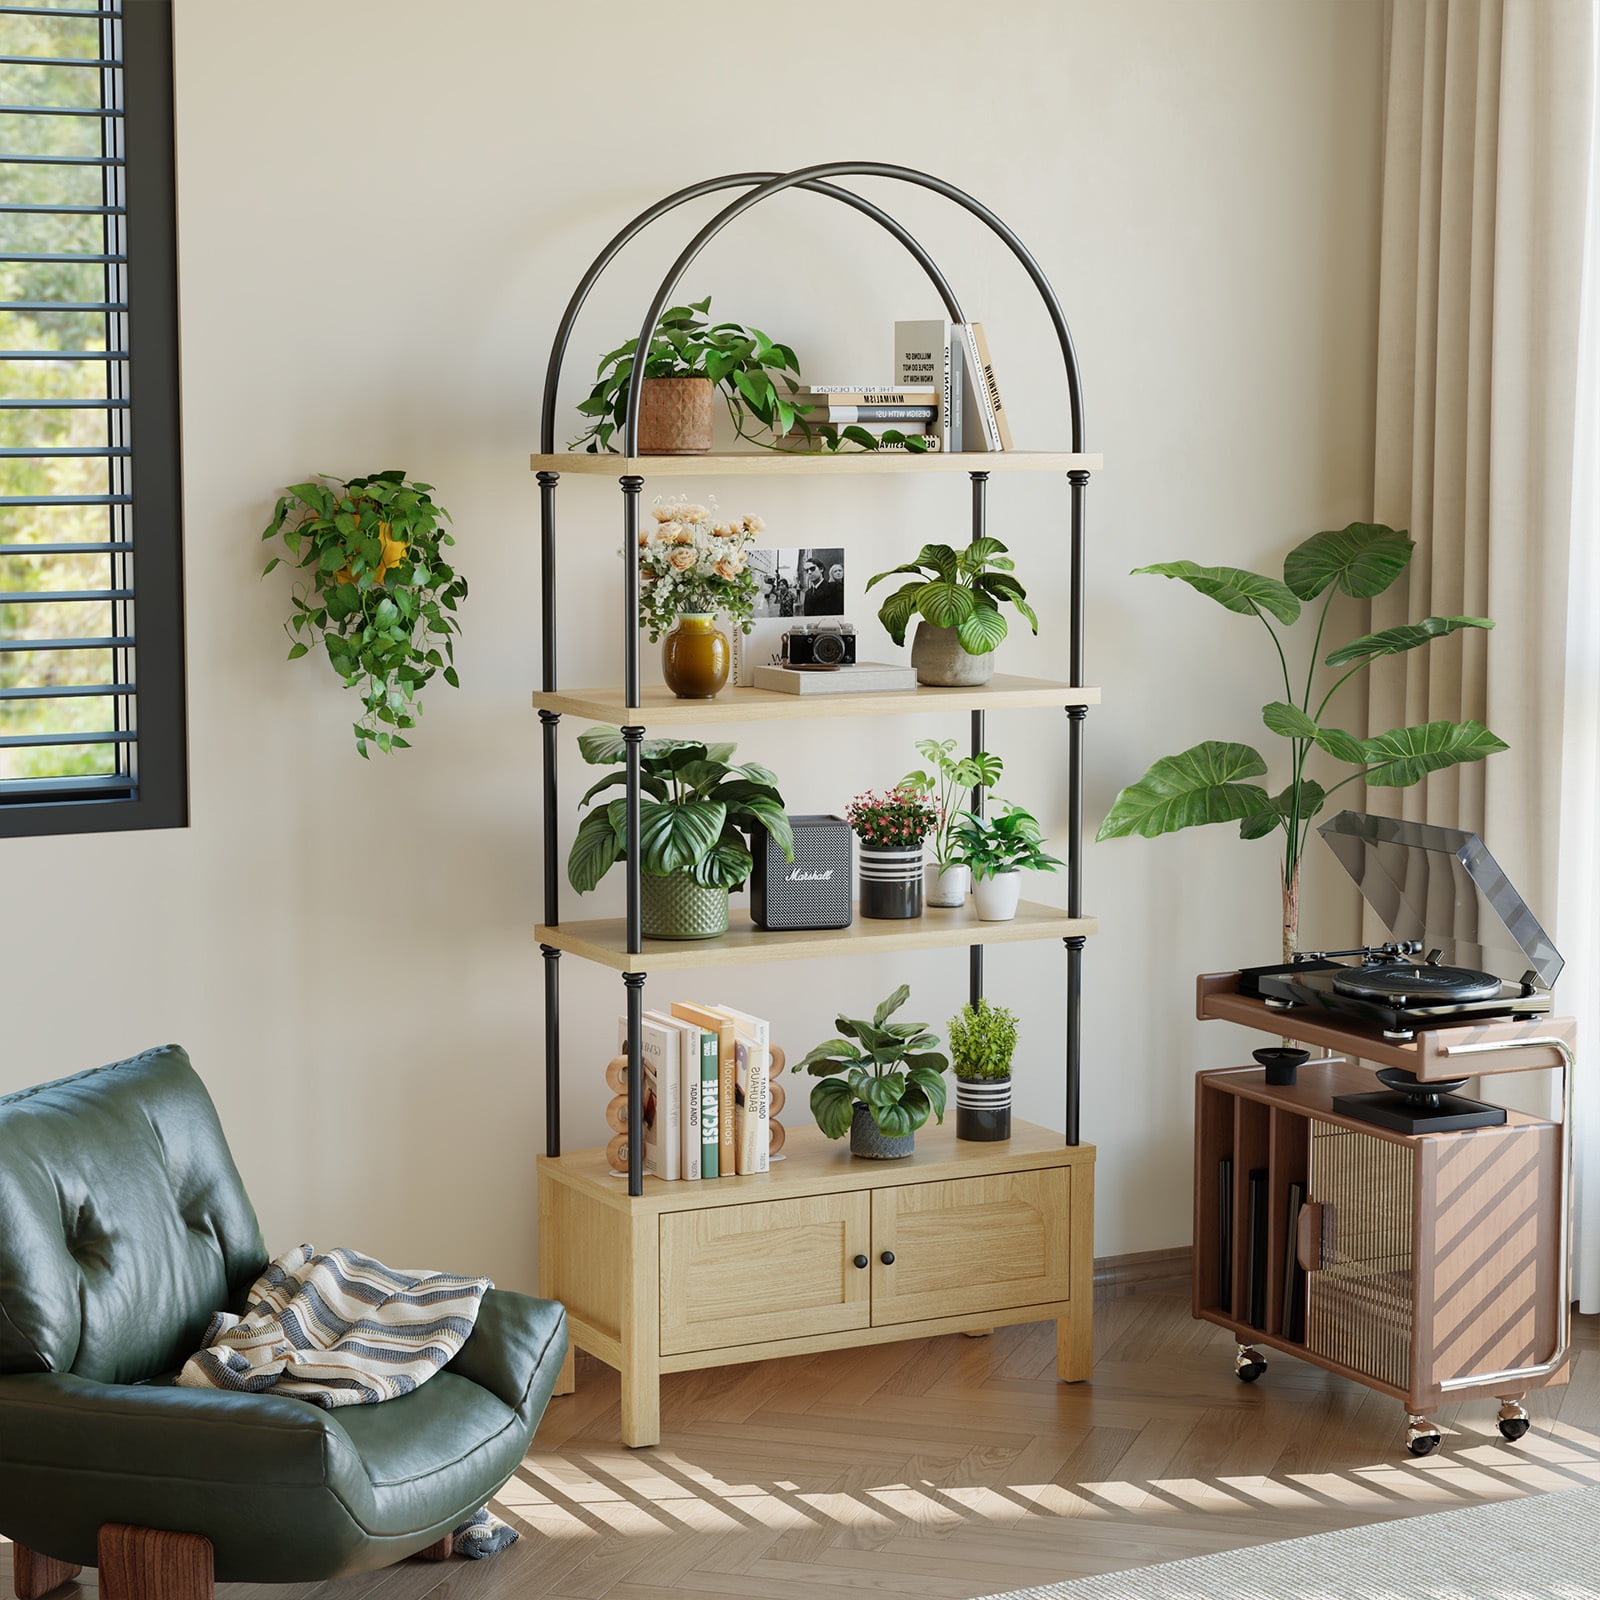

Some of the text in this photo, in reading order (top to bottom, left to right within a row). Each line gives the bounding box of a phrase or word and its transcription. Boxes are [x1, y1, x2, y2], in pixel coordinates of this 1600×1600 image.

[785, 867, 833, 881] Marshall
[690, 1083, 698, 1126] TADAO ANDO
[702, 1080, 718, 1145] ESCAPEE
